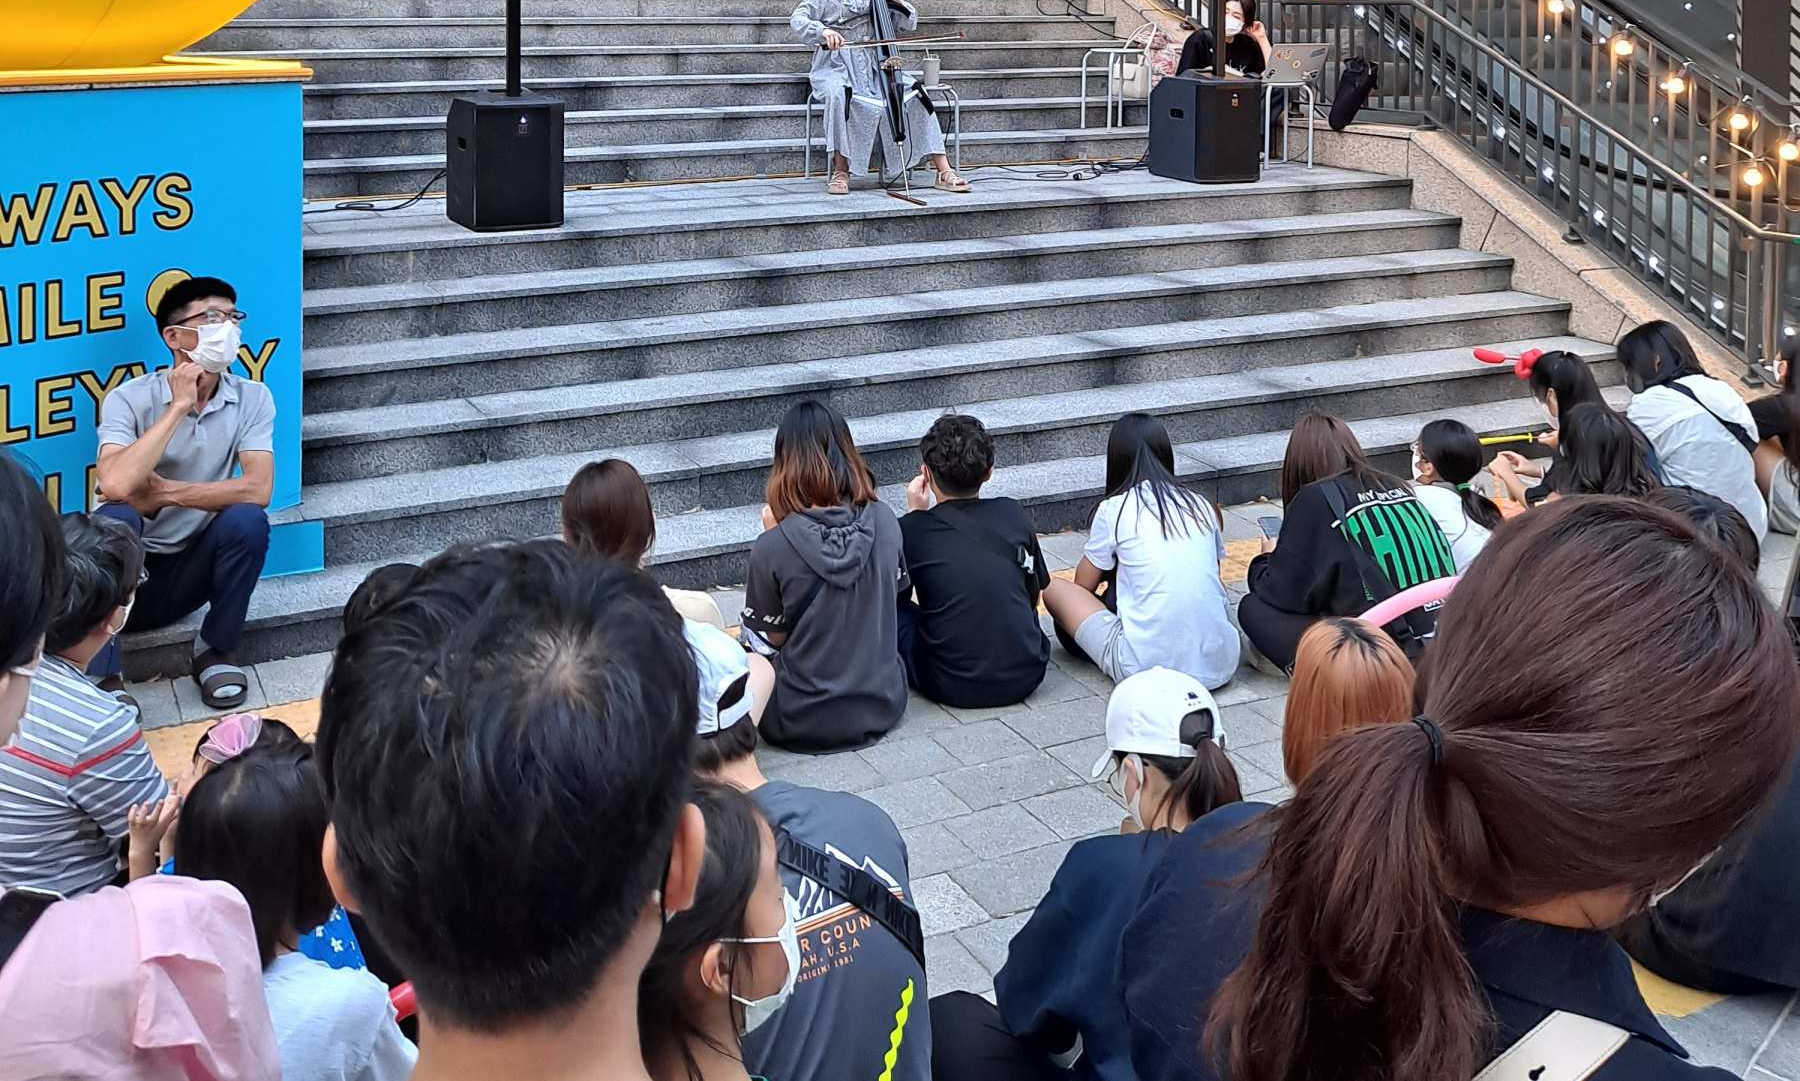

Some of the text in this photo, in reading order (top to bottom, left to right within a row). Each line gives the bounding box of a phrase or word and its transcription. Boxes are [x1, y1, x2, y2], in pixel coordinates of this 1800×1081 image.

[0, 271, 126, 348] ILE
[1357, 489, 1375, 503] MY
[788, 838, 831, 883] NIKE
[820, 914, 872, 944] COUN
